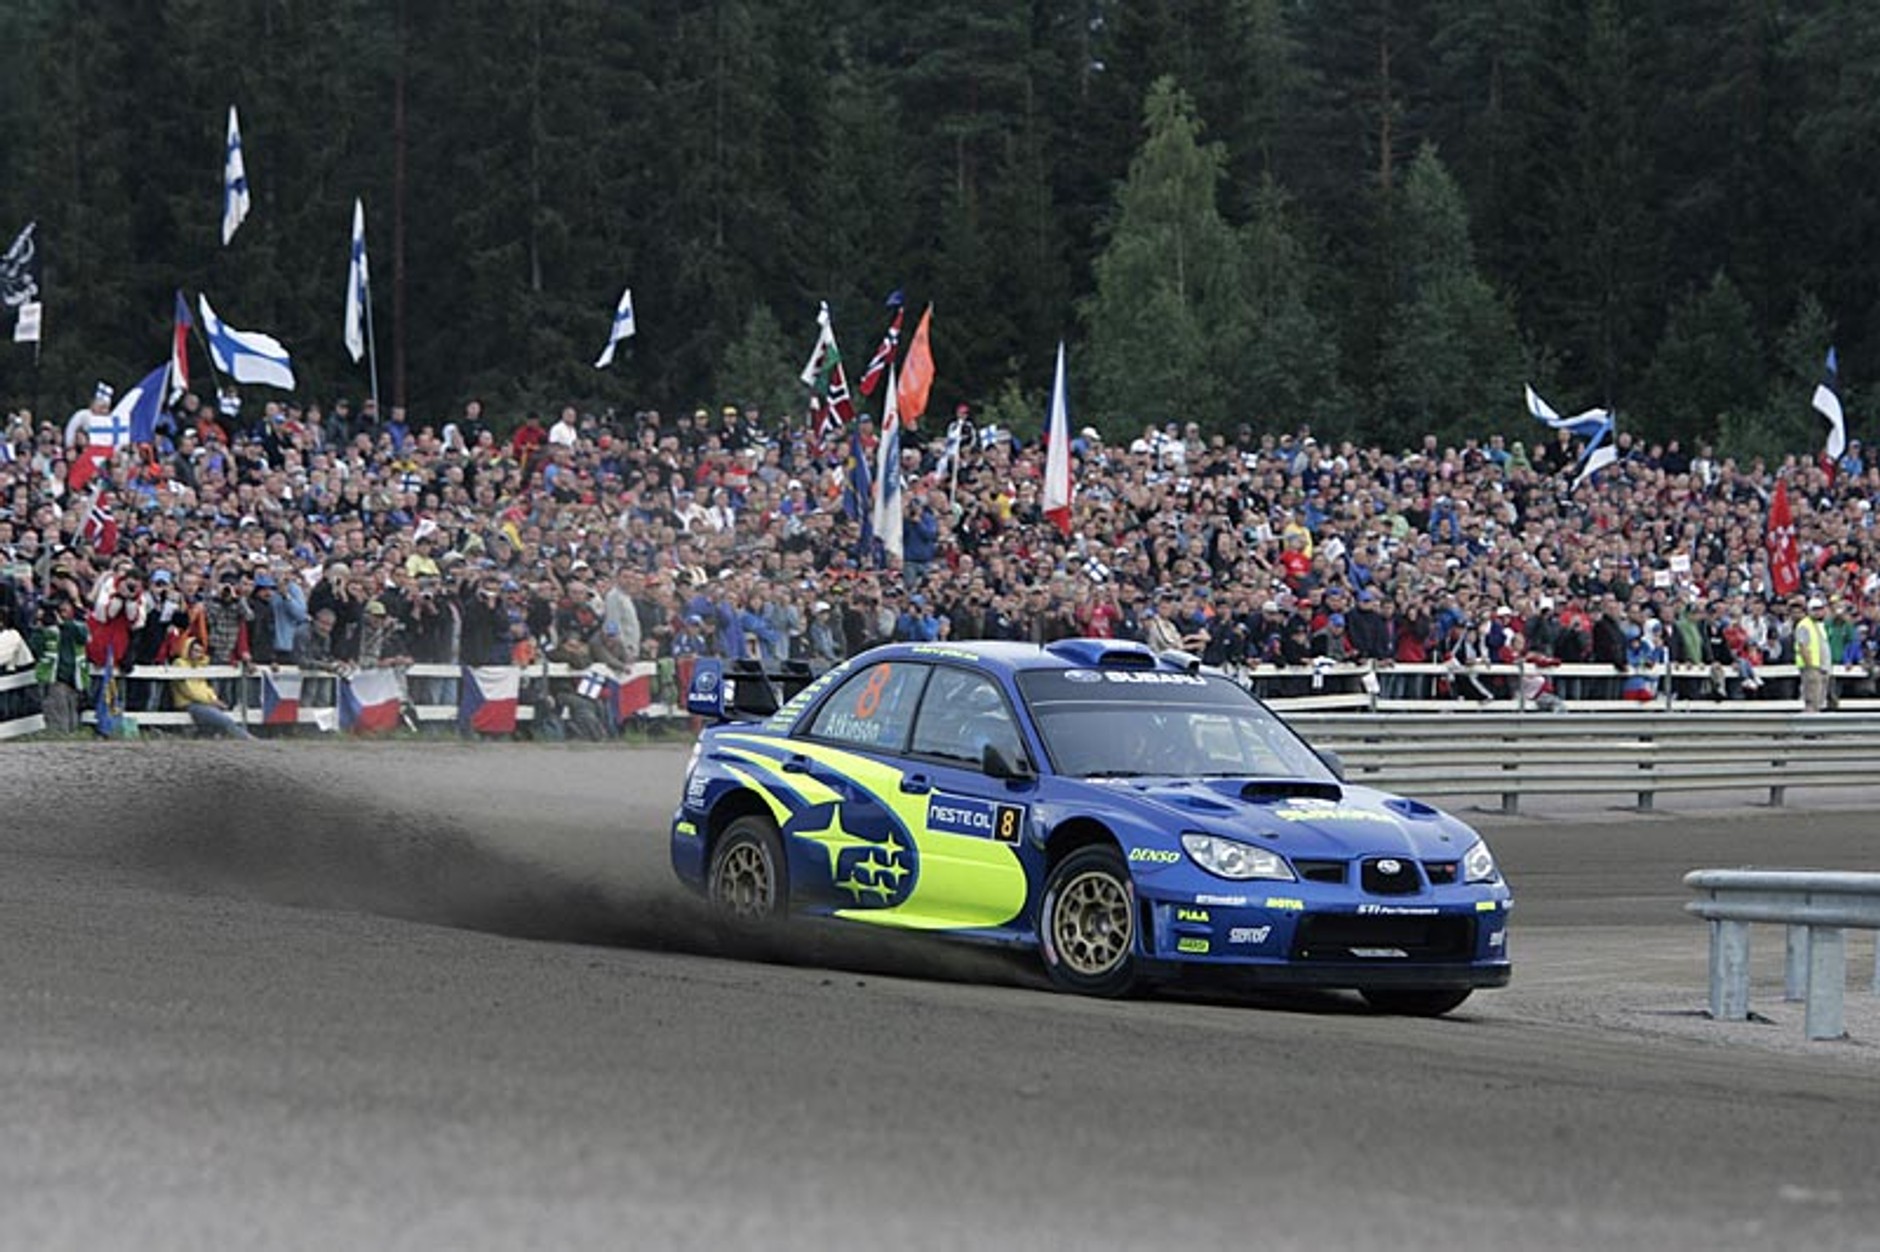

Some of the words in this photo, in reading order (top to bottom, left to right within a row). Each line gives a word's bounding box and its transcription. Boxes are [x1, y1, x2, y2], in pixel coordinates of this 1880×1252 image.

[856, 663, 891, 719] 8
[825, 712, 880, 741] Atkinson
[1001, 809, 1015, 838] 8
[1128, 847, 1181, 864] DENSO
[1177, 908, 1210, 923] PIAA
